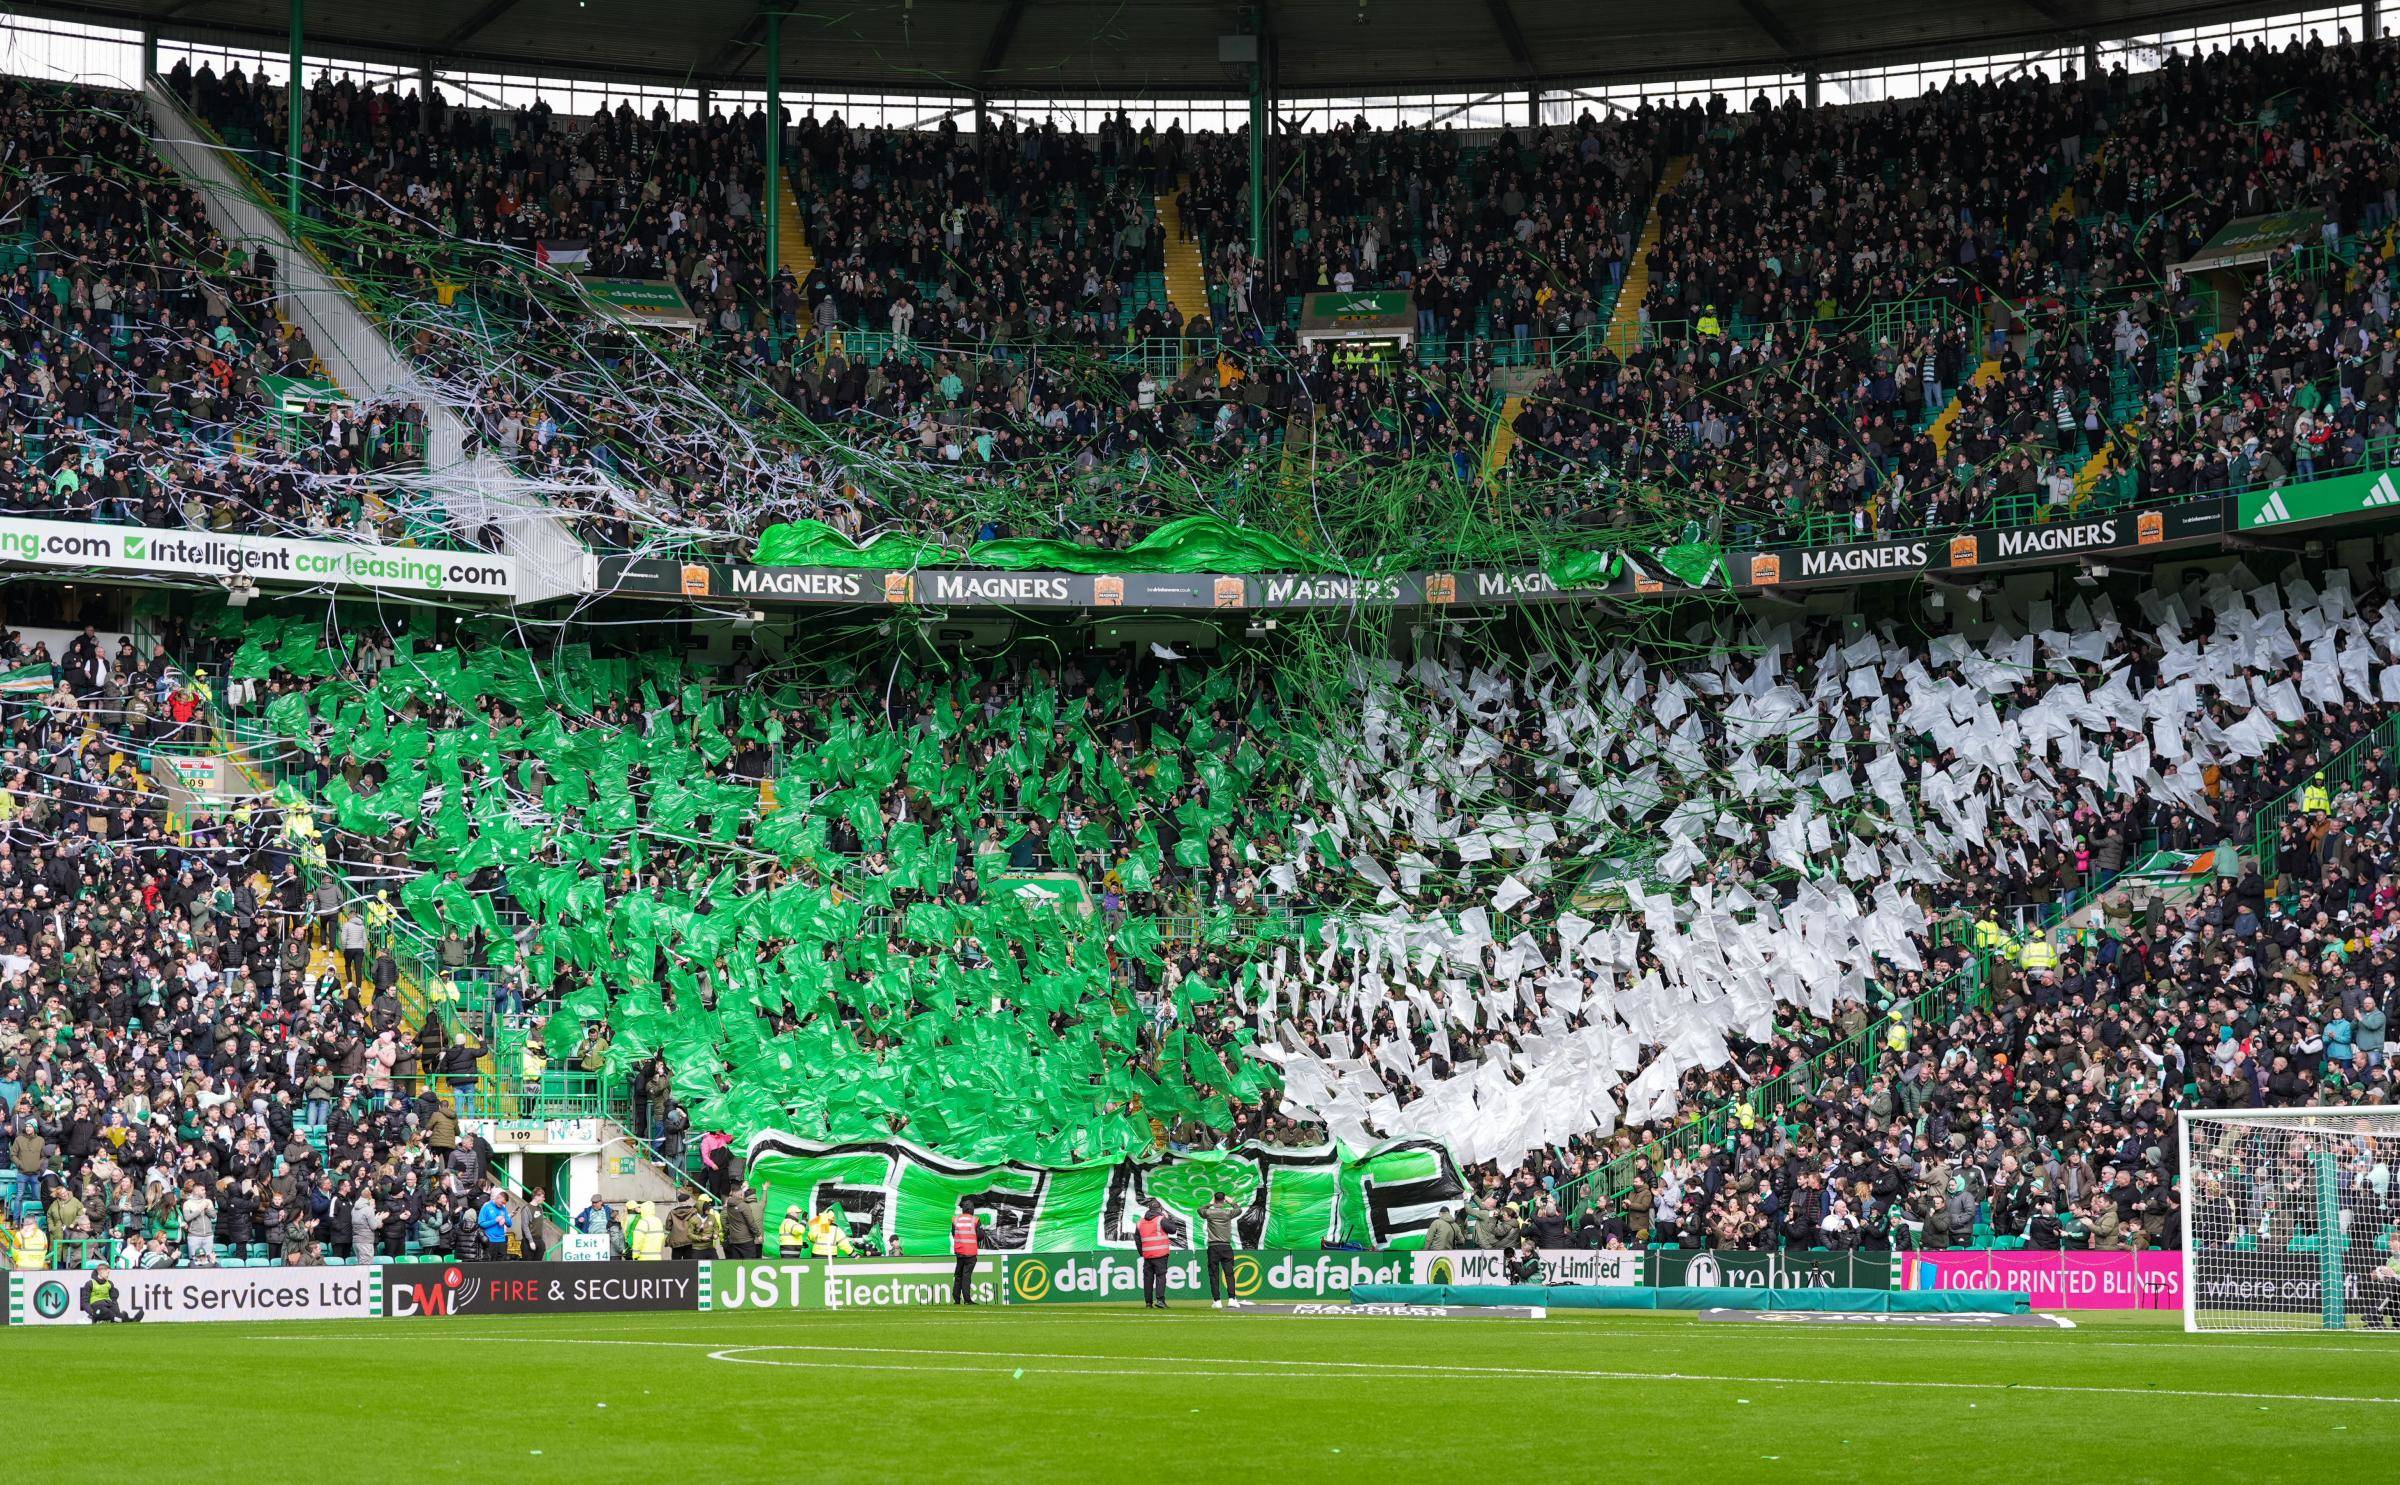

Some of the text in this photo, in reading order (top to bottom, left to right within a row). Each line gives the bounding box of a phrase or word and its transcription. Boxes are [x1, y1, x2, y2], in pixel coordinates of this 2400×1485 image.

[611, 290, 675, 299] dafabet
[1998, 519, 2117, 557] MAGNERS
[151, 538, 290, 573] Intelligent
[1802, 542, 1928, 576] MAGNERS
[732, 569, 861, 596] MAGNERS
[937, 575, 1069, 600] MAGNERS
[1268, 577, 1400, 601] MAGNERS
[1478, 572, 1610, 597] MAGN
[510, 1131, 531, 1140] 109
[564, 1251, 609, 1261] Gate 14
[575, 1239, 598, 1248] Exit
[1267, 1255, 1402, 1296] dafabet
[1461, 1256, 1499, 1278] MPC
[1561, 1255, 1620, 1279] Limited
[131, 1283, 173, 1310] Lift
[183, 1281, 310, 1310] Services
[319, 1280, 362, 1306] Ltd
[490, 1279, 539, 1301] FIRE
[547, 1279, 565, 1301] &
[573, 1278, 690, 1301] SECURITY
[721, 1265, 810, 1309] JST
[824, 1277, 995, 1307] Electroncs
[2007, 1269, 2096, 1294] PRINTED
[2103, 1270, 2179, 1295] BLINDS
[2206, 1273, 2275, 1299] where
